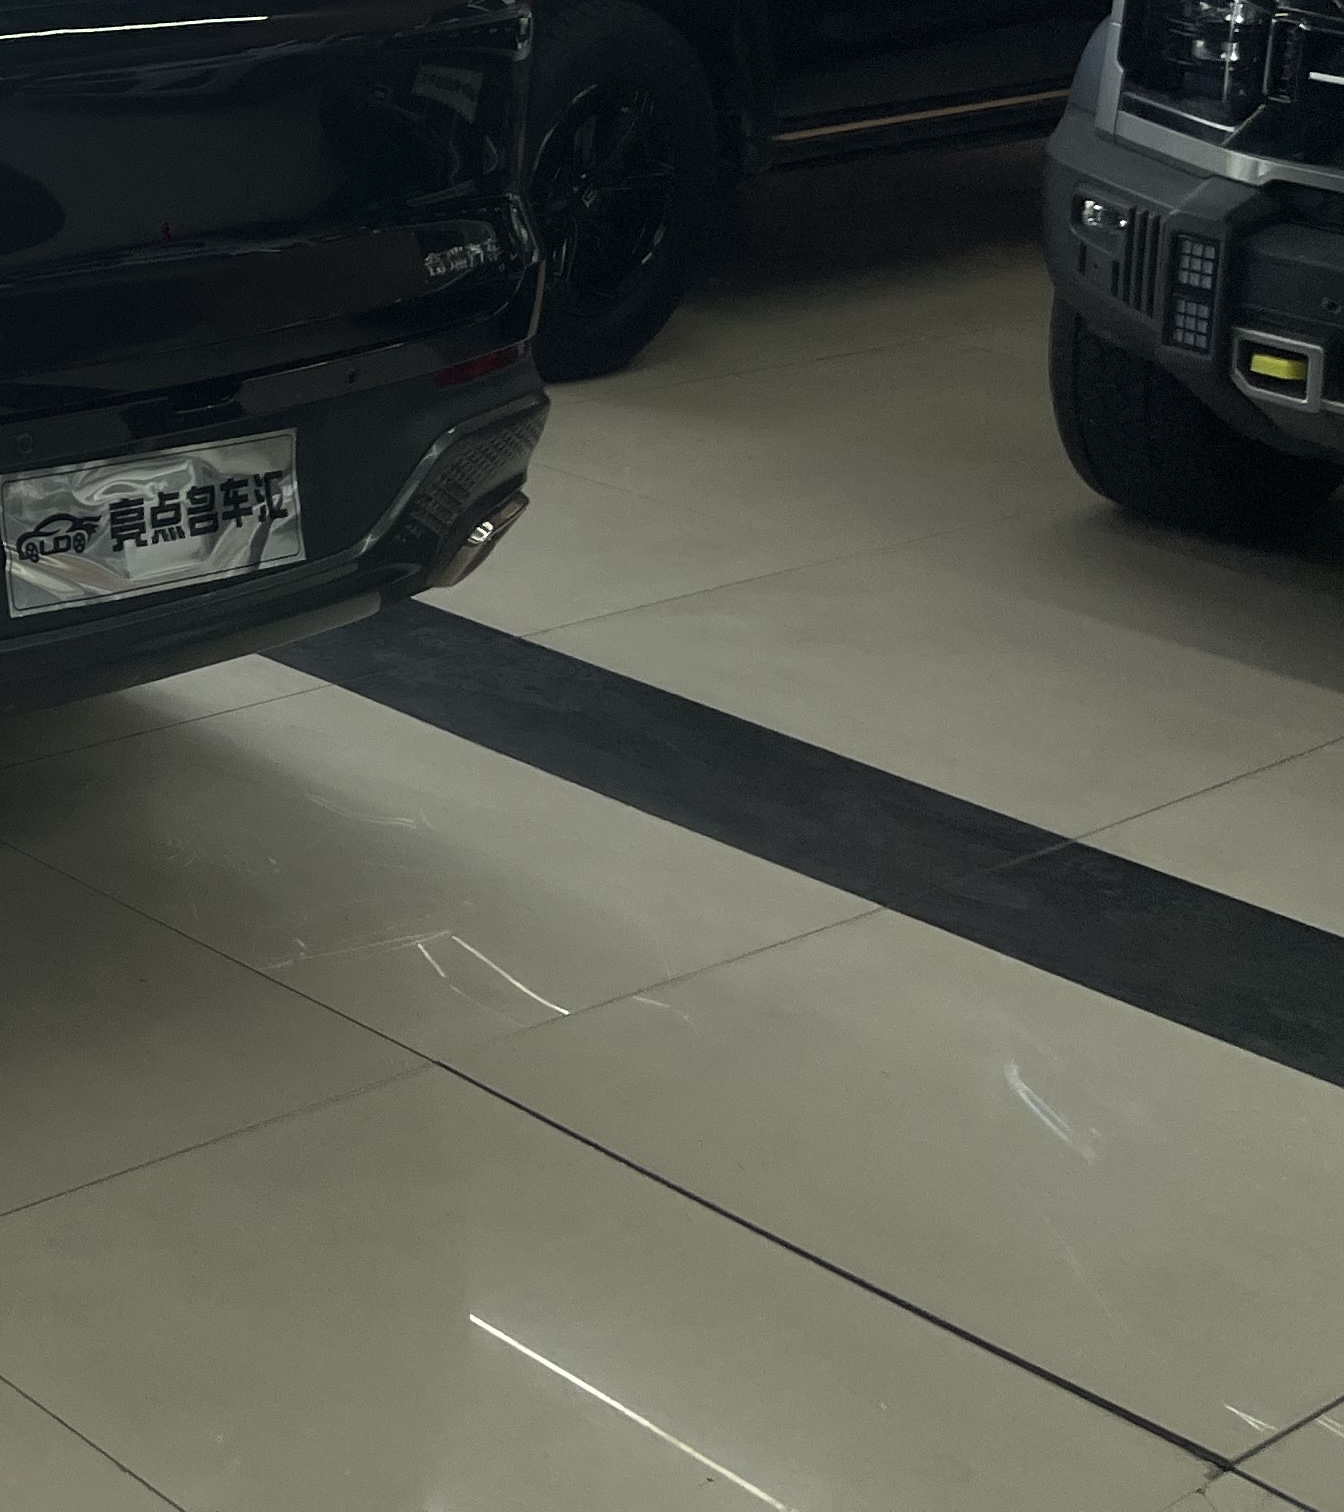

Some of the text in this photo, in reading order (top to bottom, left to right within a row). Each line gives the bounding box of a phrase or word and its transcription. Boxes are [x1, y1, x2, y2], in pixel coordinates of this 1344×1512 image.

[108, 470, 289, 552] 亮点名车汇
